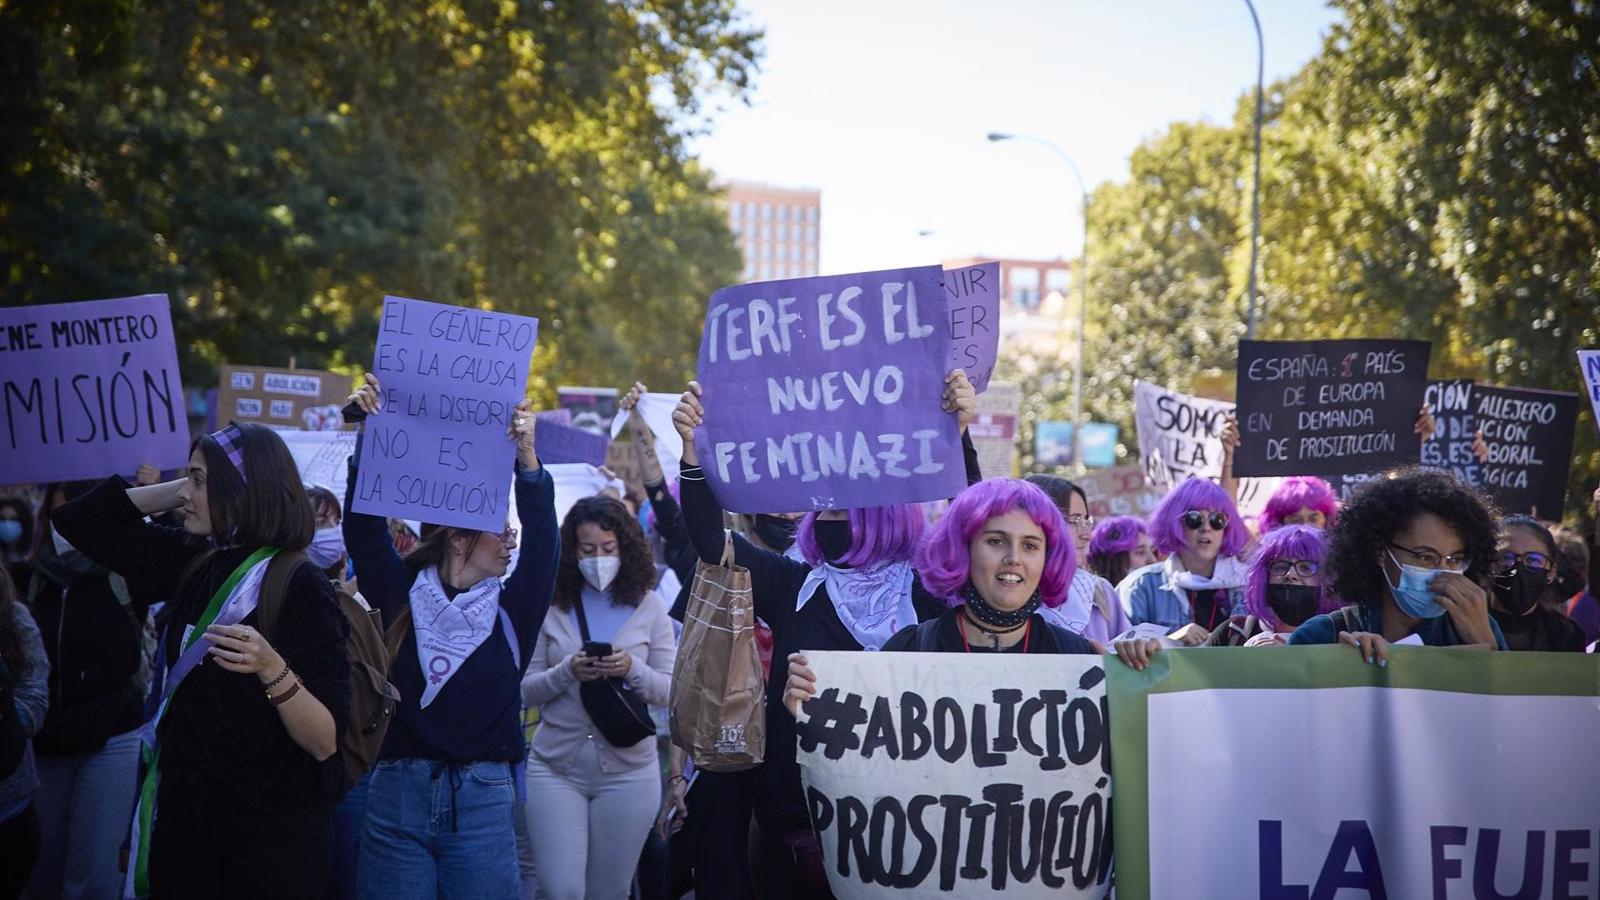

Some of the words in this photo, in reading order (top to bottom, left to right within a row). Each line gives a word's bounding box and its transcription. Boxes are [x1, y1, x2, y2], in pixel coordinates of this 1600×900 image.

[51, 314, 158, 348] MONTERO
[383, 302, 412, 335] EL
[429, 309, 532, 351] GÉNERO
[707, 297, 801, 363] TERF
[817, 286, 866, 351] ES
[881, 280, 934, 345] EL
[379, 344, 407, 372] ES
[417, 350, 439, 376] LA
[451, 355, 517, 386] CAUSA
[4, 352, 176, 449] MISIÓN
[408, 394, 428, 417] LA
[767, 364, 905, 415] NUEVO
[1283, 386, 1306, 407] DE
[1319, 381, 1385, 404] EUROPA
[1424, 380, 1472, 413] CIÓN
[1475, 392, 1556, 424] ALLEJERO
[1155, 396, 1236, 438] SOMO
[1248, 412, 1273, 432] EN
[1298, 408, 1374, 430] DEMANDA
[1450, 415, 1474, 440] DE
[371, 428, 410, 459] NO
[438, 437, 473, 472] ES
[714, 429, 945, 483] FEMINAZI
[1174, 439, 1208, 466] LA
[1267, 438, 1290, 460] DE
[1299, 429, 1396, 459] PROSTITUCIÓN
[1450, 441, 1473, 464] ES
[359, 471, 383, 501] LA
[394, 474, 498, 514] SOLUCIÓN
[1259, 820, 1389, 900] LA
[1430, 825, 1600, 900] FUE
